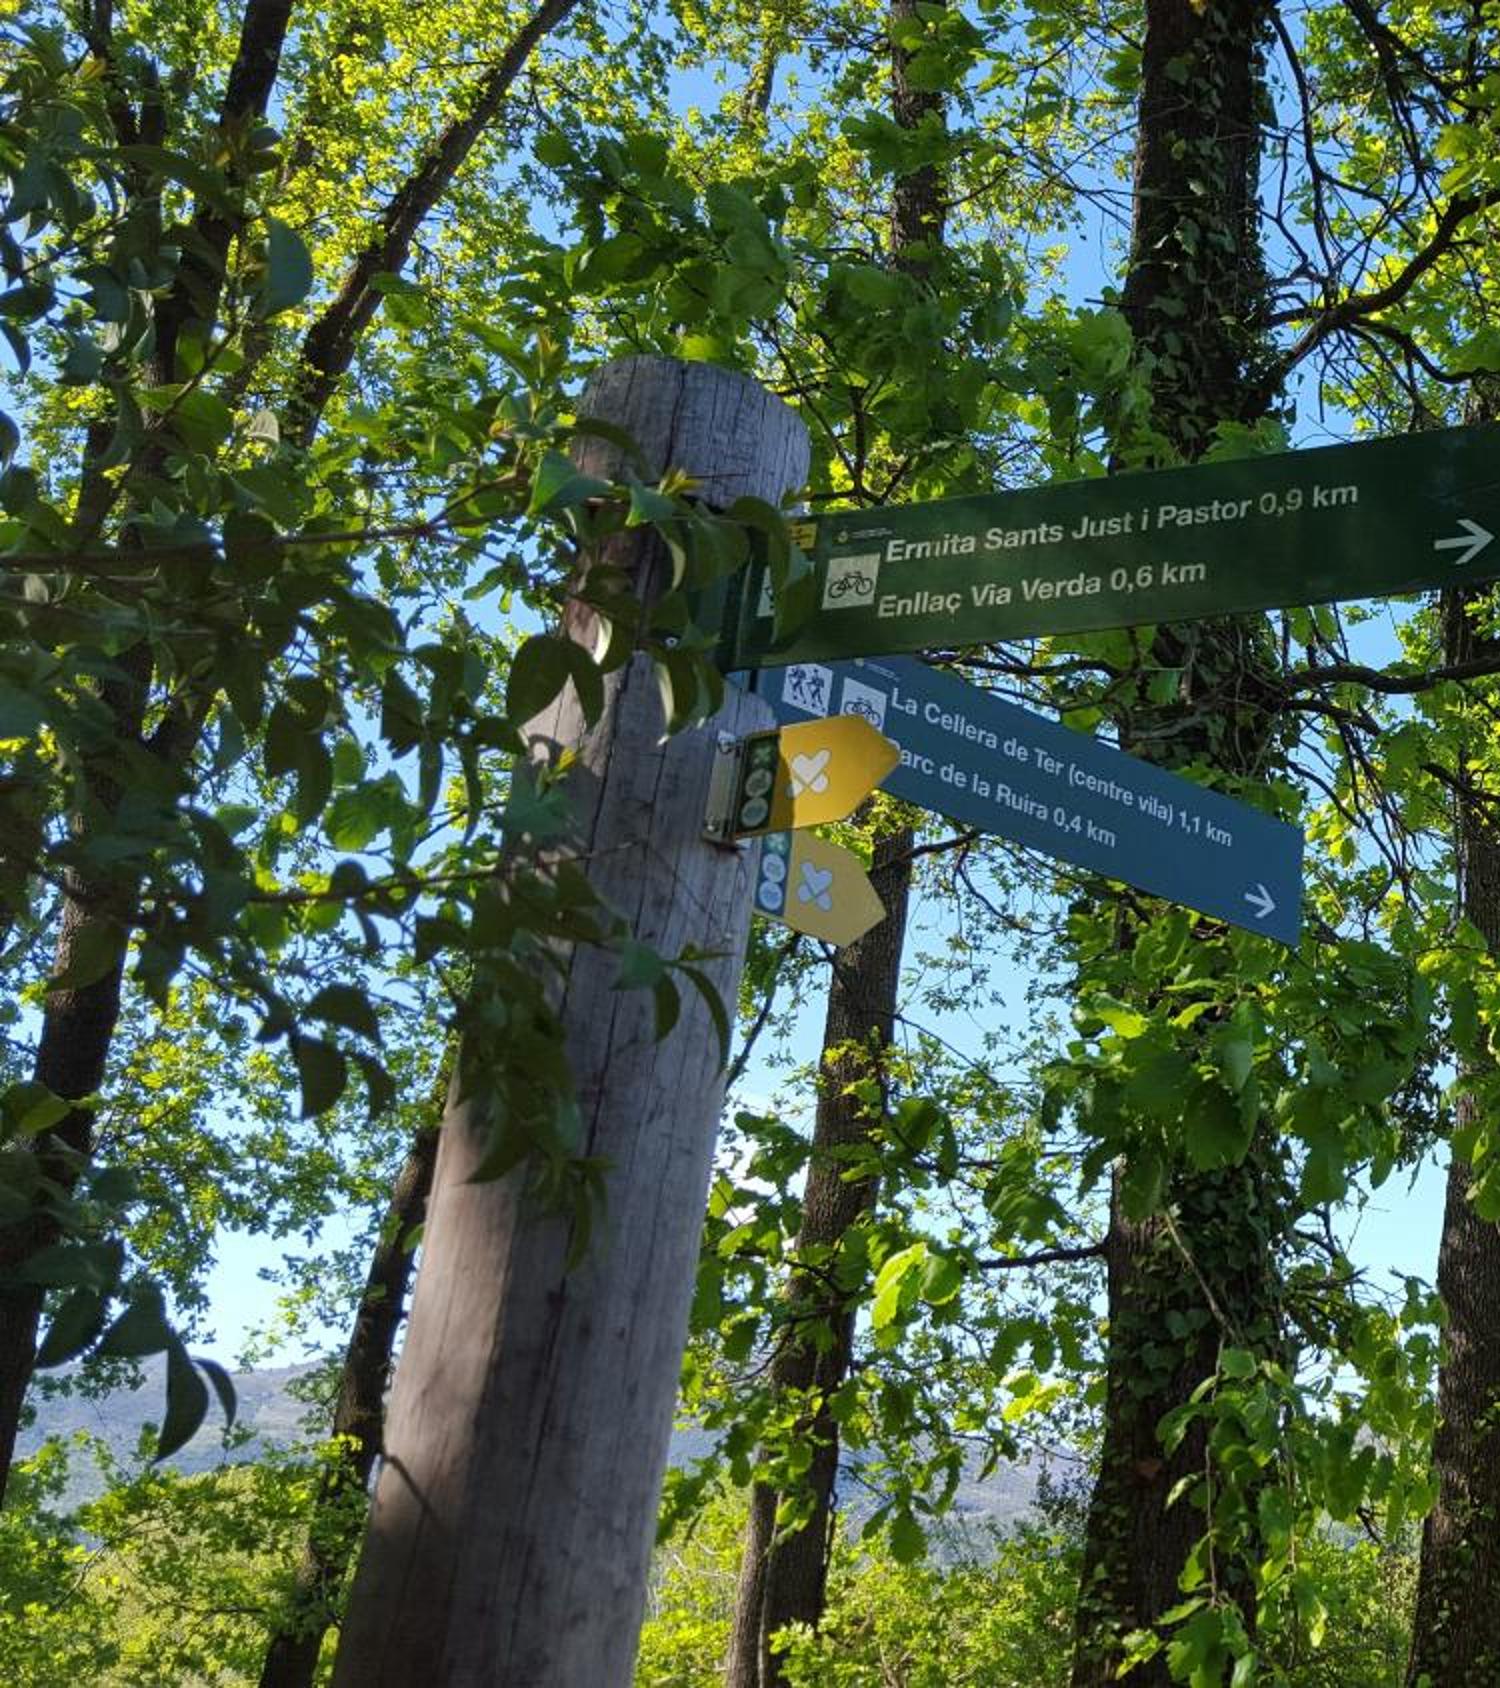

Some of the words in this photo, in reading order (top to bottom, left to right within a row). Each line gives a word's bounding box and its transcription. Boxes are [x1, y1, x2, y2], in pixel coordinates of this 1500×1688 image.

[886, 534, 975, 562] Ermita
[984, 522, 1063, 550] Sants
[1072, 512, 1133, 539] Just
[1141, 509, 1149, 531] i
[1157, 500, 1252, 529] Pastor
[1259, 489, 1303, 517] 0,9
[1313, 484, 1358, 508] km
[878, 591, 962, 617] Enllaç
[971, 583, 1011, 607] Via
[1021, 572, 1101, 600] Verda
[1111, 565, 1152, 593] 0,6
[1161, 562, 1206, 585] km
[891, 687, 917, 716] La
[925, 703, 997, 749] Cellera
[1003, 738, 1028, 761] de
[1034, 747, 1064, 776] Ter
[1069, 763, 1134, 806] (centre
[1138, 795, 1174, 827] vila)
[1179, 811, 1201, 834] 1,1
[1206, 820, 1233, 847] km
[940, 763, 967, 788] de
[973, 774, 990, 798] la
[995, 784, 1048, 820] Ruira
[1053, 807, 1082, 833] 0,4
[1088, 819, 1117, 848] km
